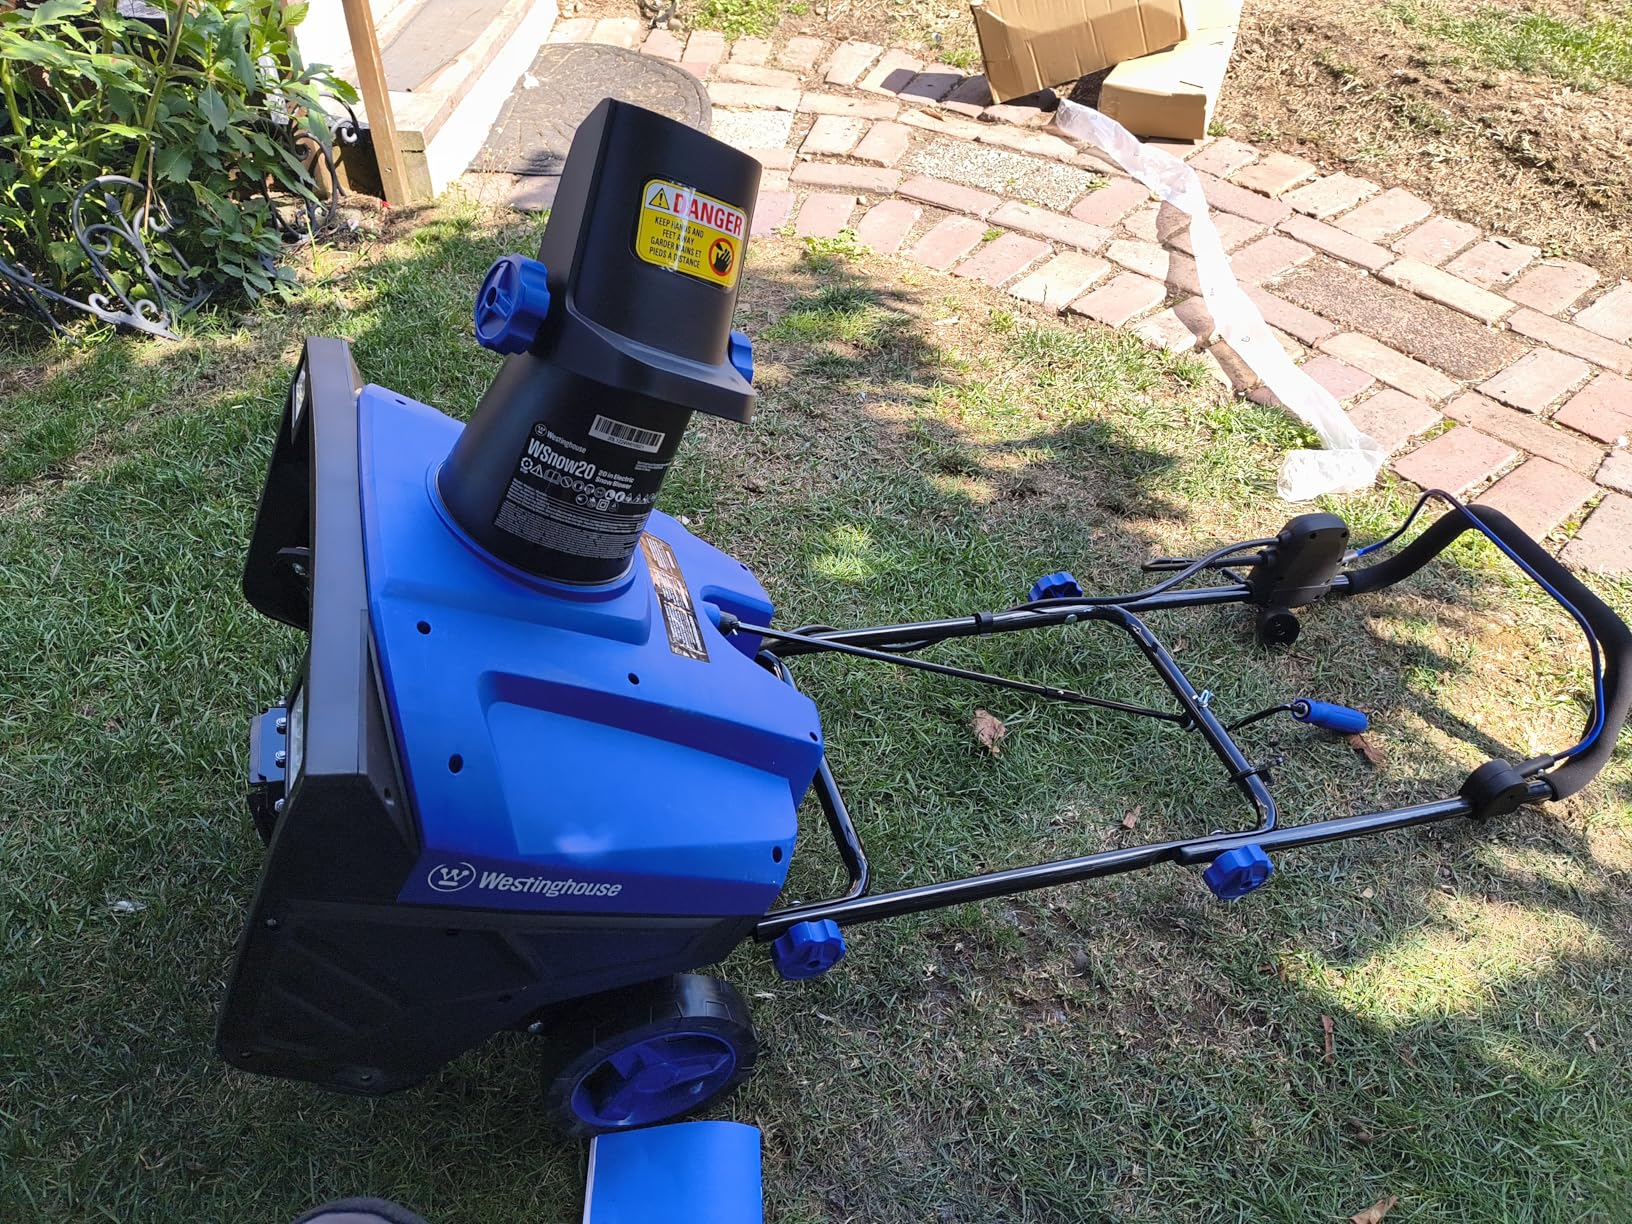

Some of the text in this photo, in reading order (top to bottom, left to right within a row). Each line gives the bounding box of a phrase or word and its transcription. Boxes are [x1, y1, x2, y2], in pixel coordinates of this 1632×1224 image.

[672, 193, 743, 237] DANGER
[654, 216, 671, 227] KEEP
[692, 228, 704, 239] AND
[662, 229, 676, 240] FEET
[649, 246, 667, 259] PIEDS
[673, 253, 701, 269] DSTANCE
[650, 236, 675, 250] GARDER
[694, 250, 702, 259] ET
[547, 431, 587, 454] Westinghouse
[527, 438, 597, 480] WSnow20
[594, 475, 613, 486] Snow
[479, 871, 623, 898] Westinghouse
